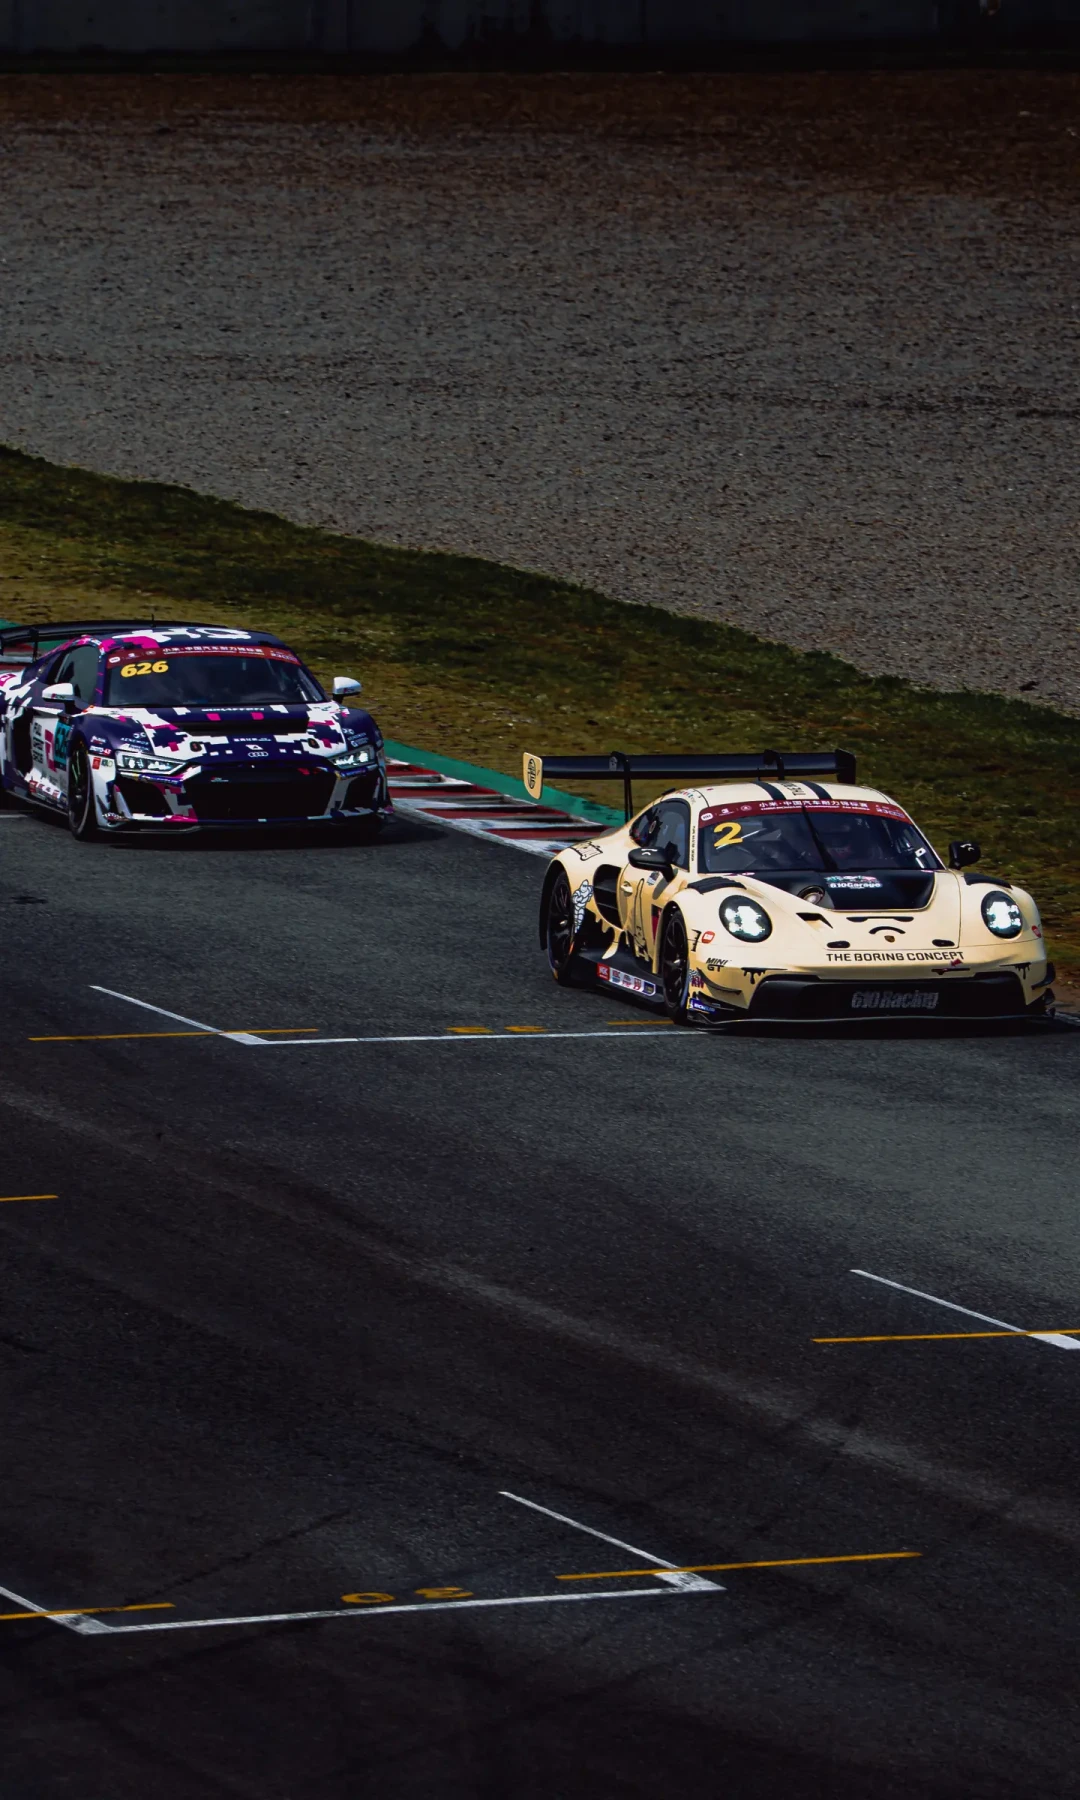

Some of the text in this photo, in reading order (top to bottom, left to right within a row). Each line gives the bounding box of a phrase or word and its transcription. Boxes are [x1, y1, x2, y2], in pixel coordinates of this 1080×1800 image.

[120, 660, 169, 678] 626
[713, 821, 743, 848] 2
[705, 957, 728, 966] MINI
[826, 951, 965, 962] THE BORING CONCEPT
[707, 963, 724, 973] GT
